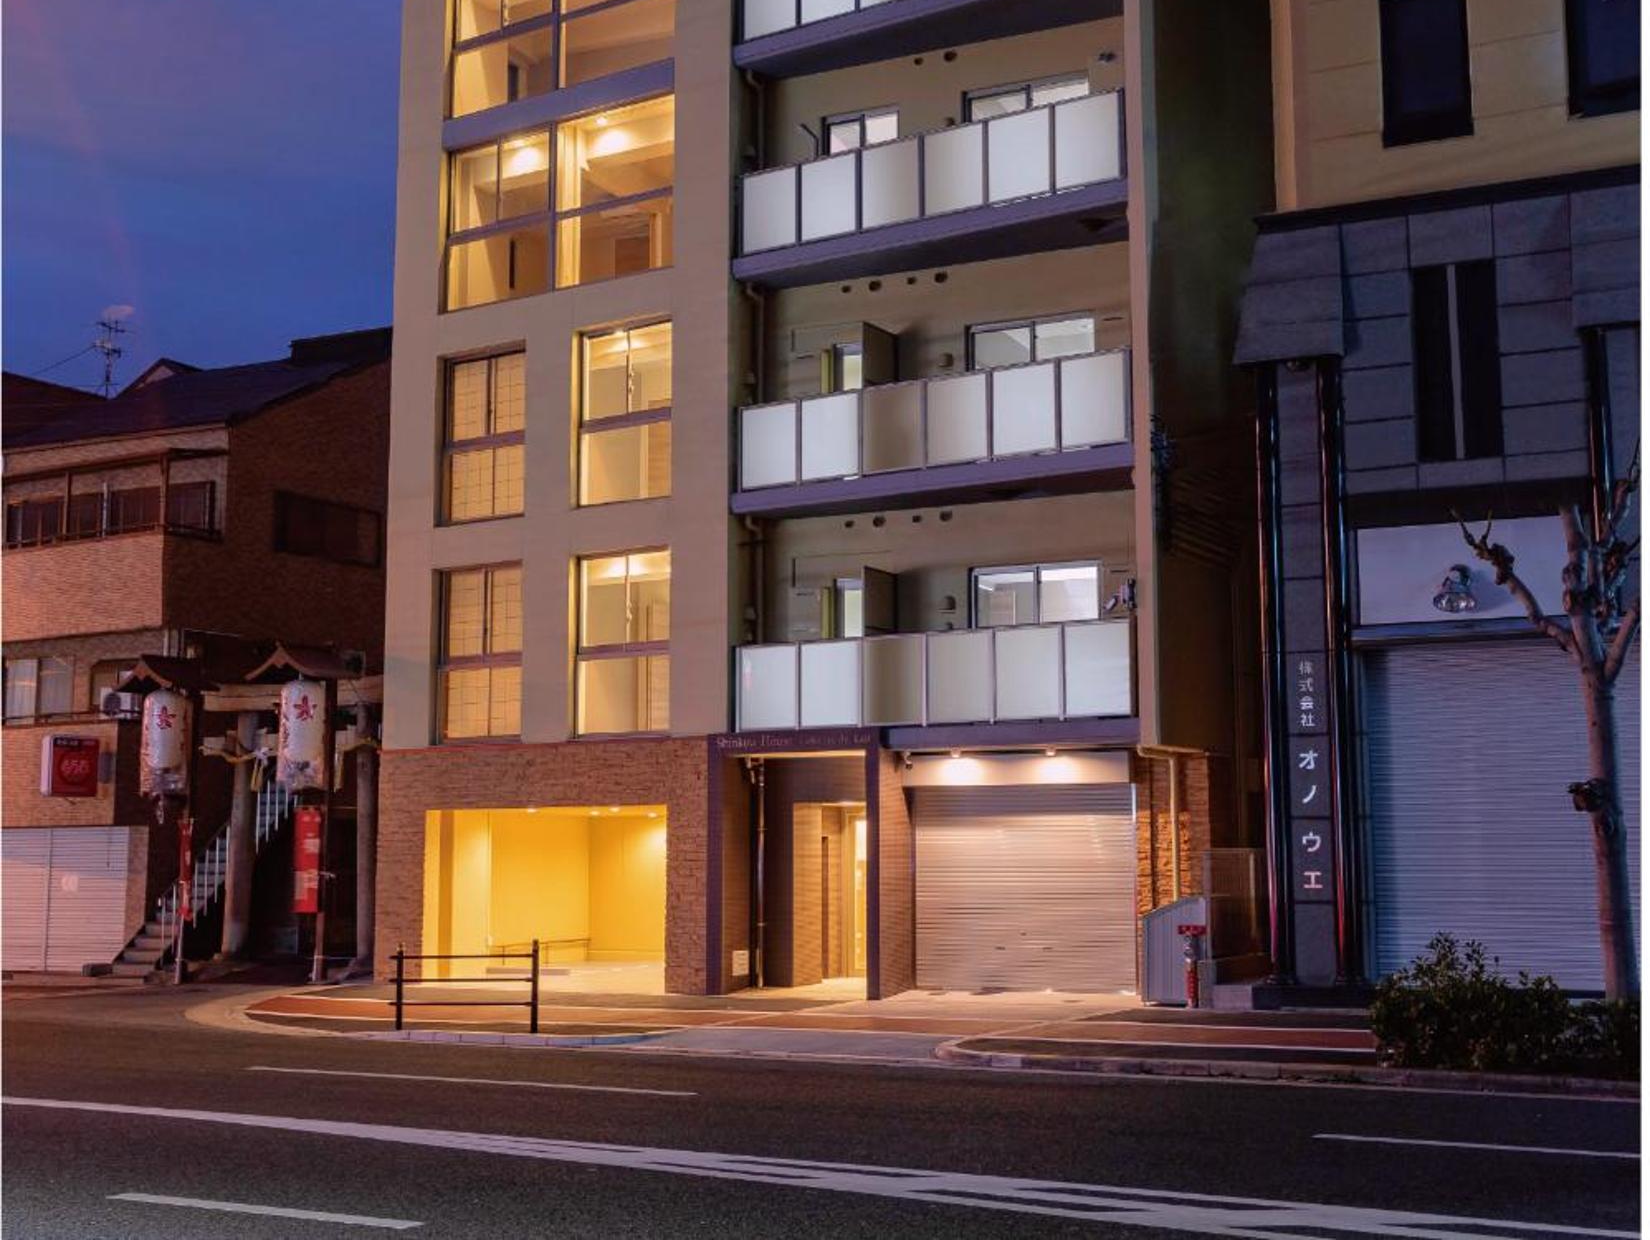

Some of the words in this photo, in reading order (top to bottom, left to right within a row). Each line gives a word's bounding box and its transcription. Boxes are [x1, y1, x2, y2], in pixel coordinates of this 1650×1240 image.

[1299, 661, 1316, 727] 株式会社
[1298, 750, 1323, 889] オノウエ
